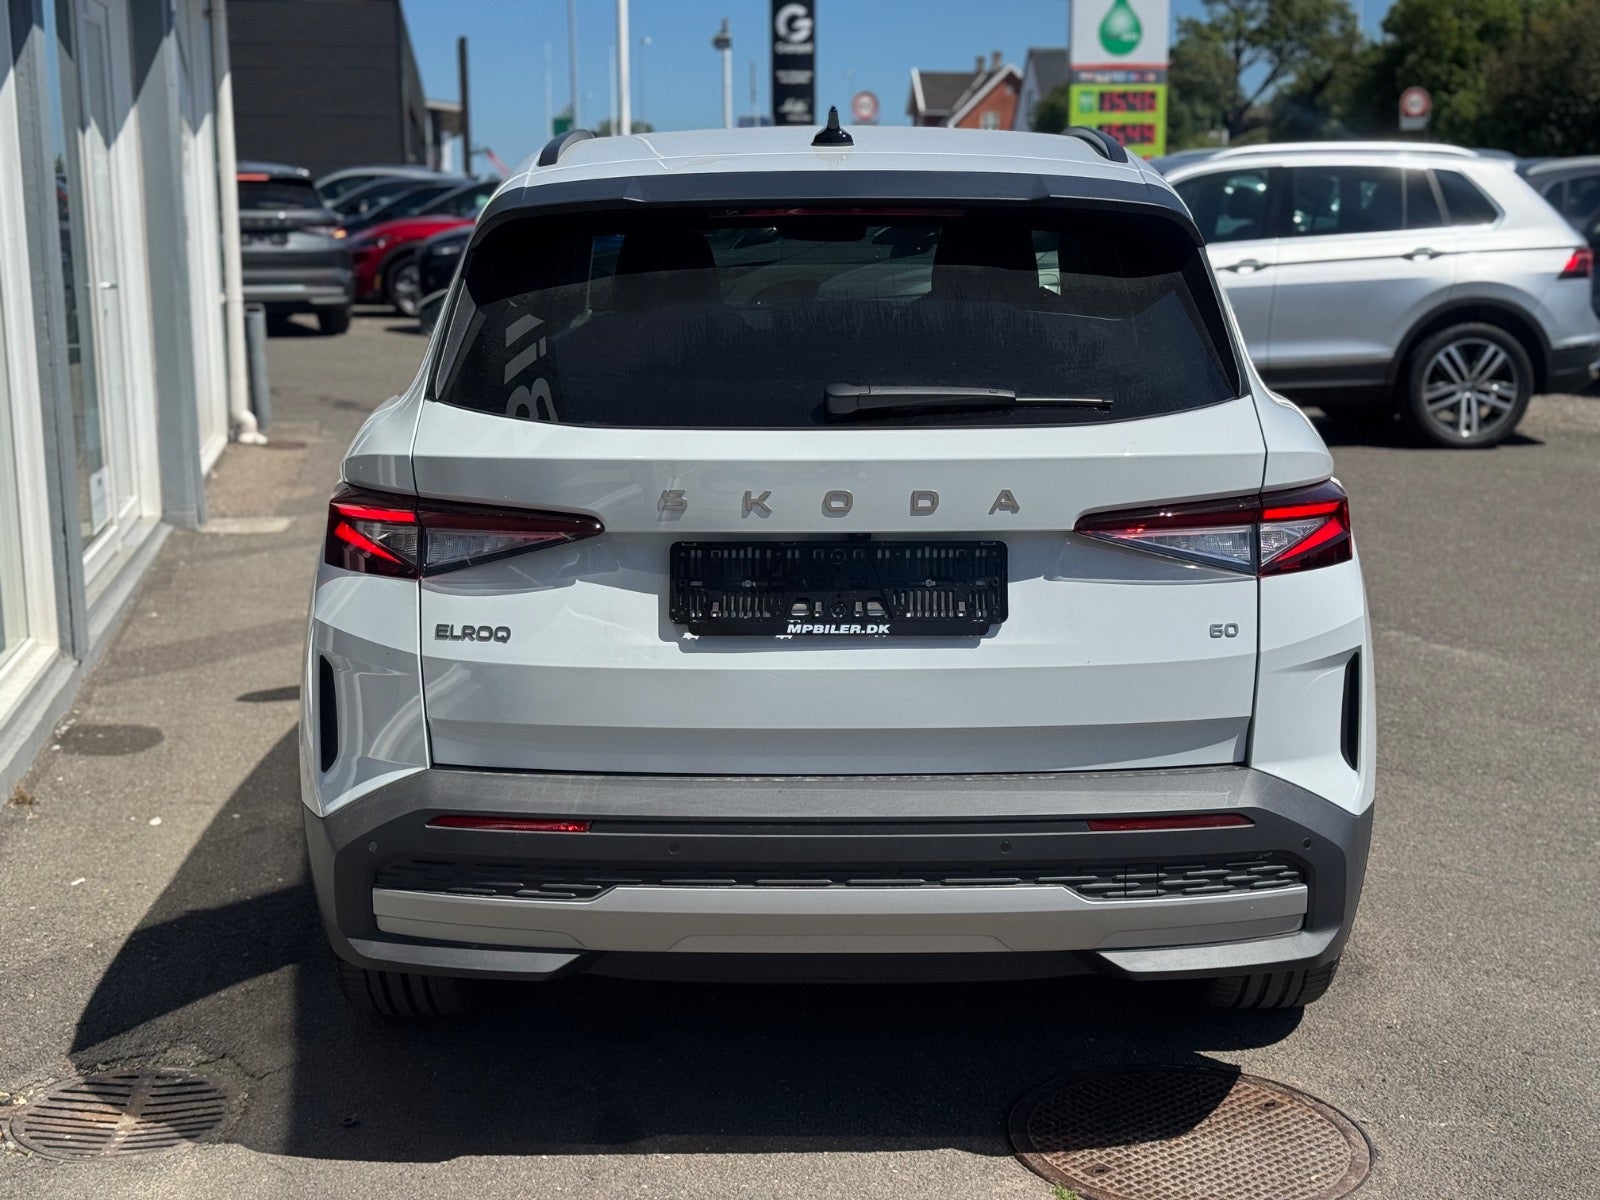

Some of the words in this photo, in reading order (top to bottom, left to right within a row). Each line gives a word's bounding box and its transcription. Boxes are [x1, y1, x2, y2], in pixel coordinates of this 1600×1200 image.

[434, 623, 511, 644] ELROQ
[786, 624, 891, 634] MPBILER.DK
[1209, 622, 1239, 639] 60
